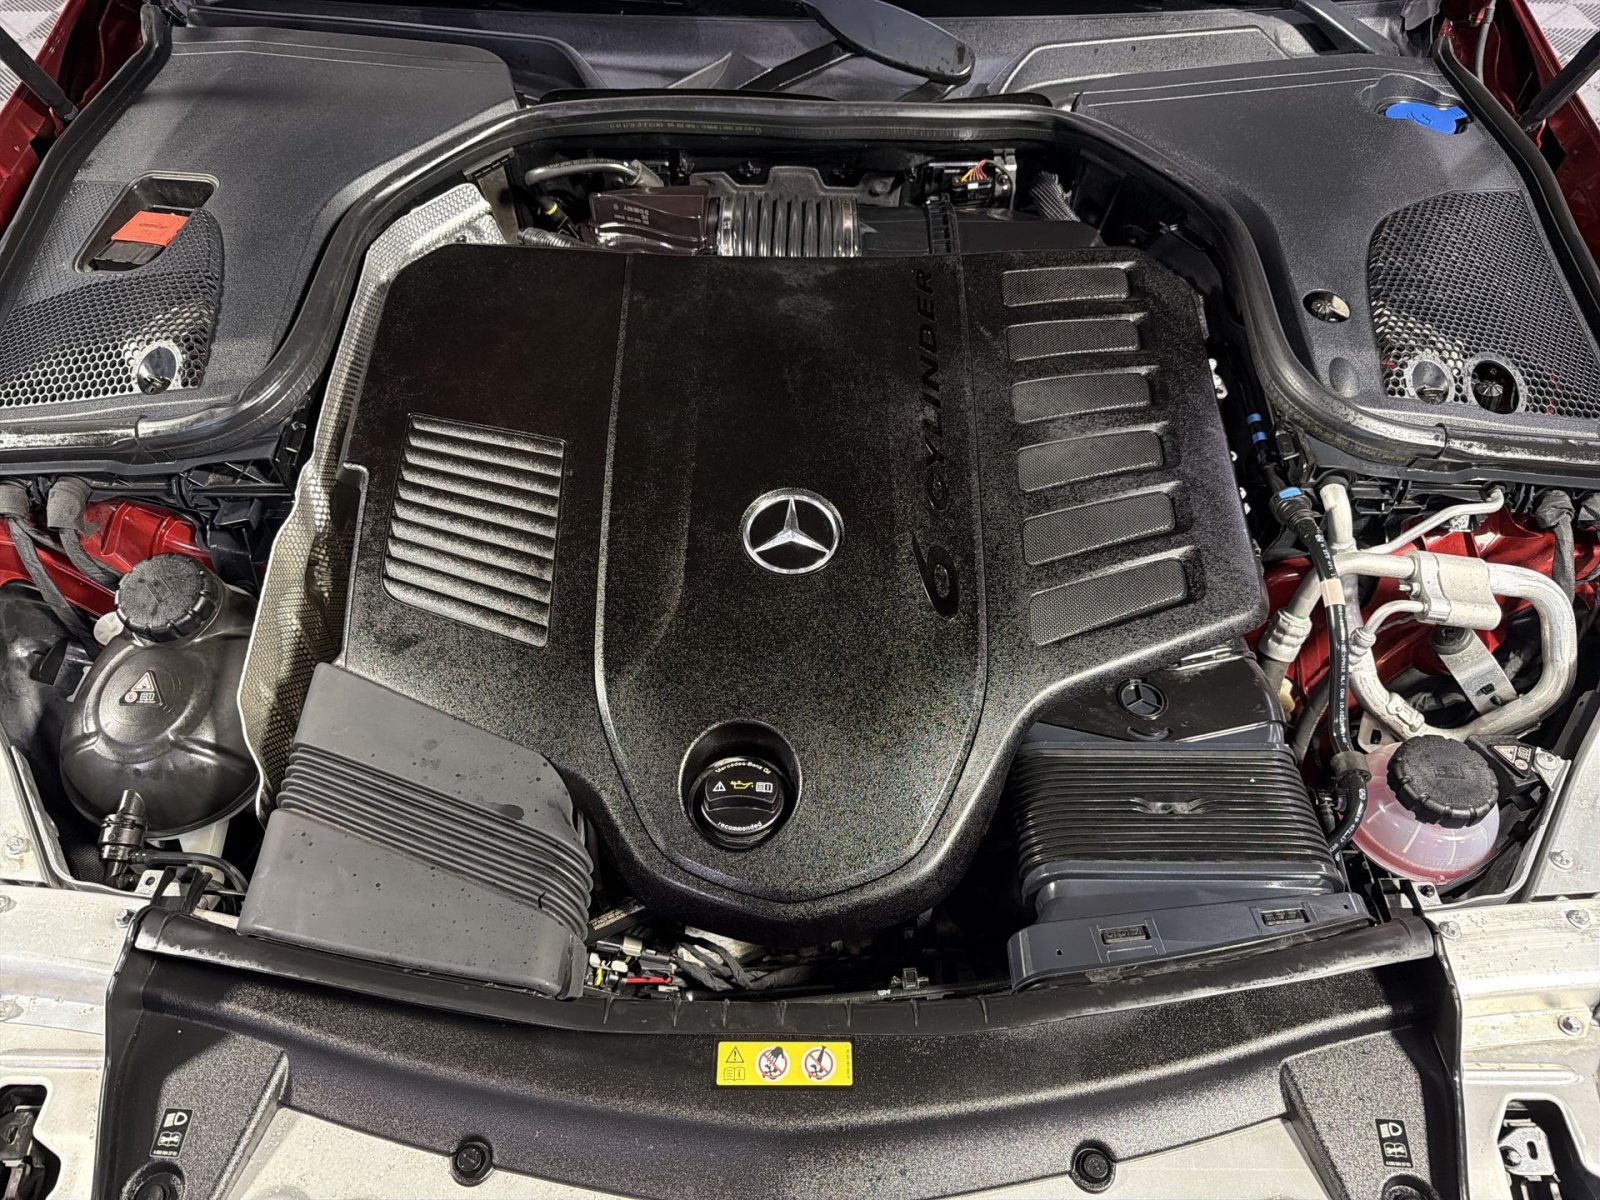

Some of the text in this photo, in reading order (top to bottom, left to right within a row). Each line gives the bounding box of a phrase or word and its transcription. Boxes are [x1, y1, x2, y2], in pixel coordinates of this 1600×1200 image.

[911, 268, 959, 618] 6 CYLINDER
[715, 761, 763, 773] Mercedes-Benz
[717, 820, 762, 831] recommended
